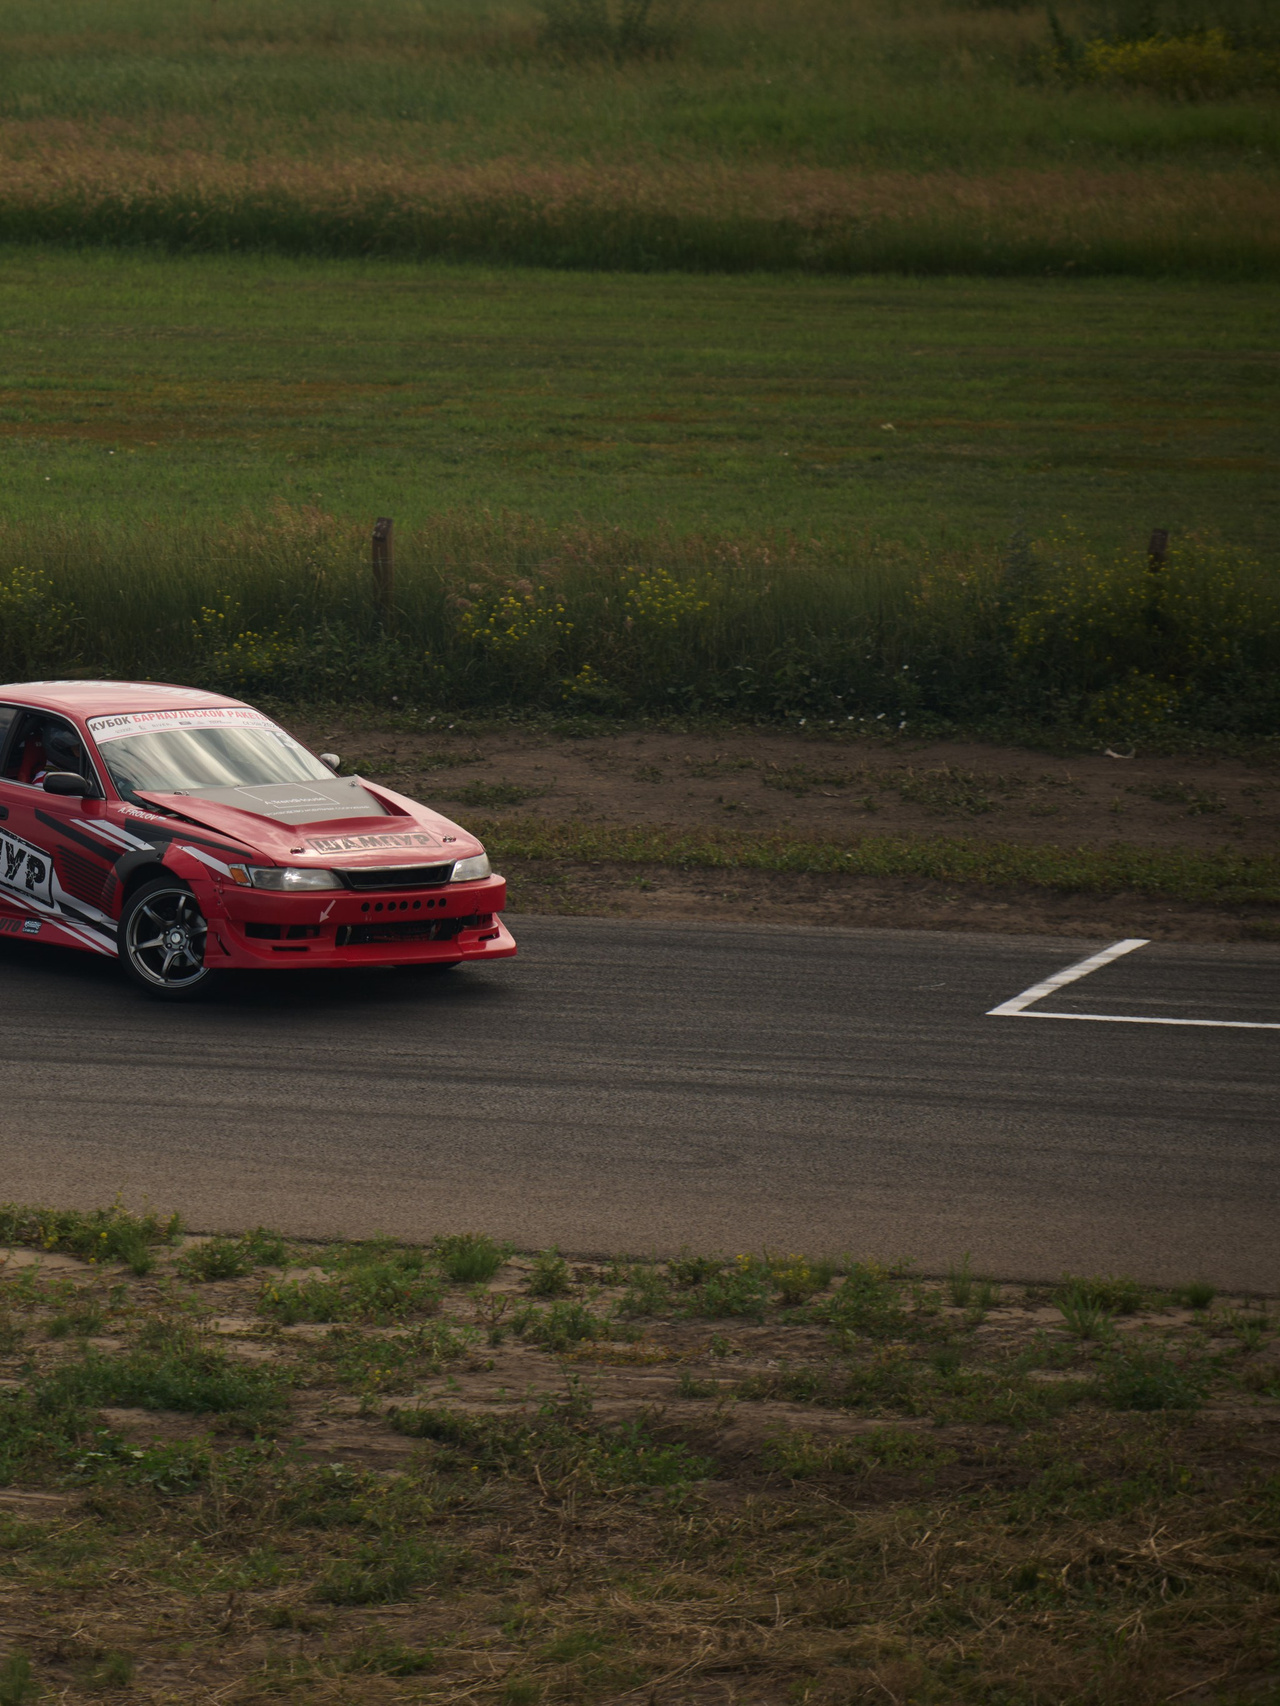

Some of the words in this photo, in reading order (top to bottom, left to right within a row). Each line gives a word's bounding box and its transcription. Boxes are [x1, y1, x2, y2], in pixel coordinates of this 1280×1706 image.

[90, 715, 131, 732] КУБОК
[132, 710, 224, 723] БАРНАУЛЬСКОЙ
[118, 807, 158, 821] A.FROLOV
[313, 834, 430, 852] ШАМПУР
